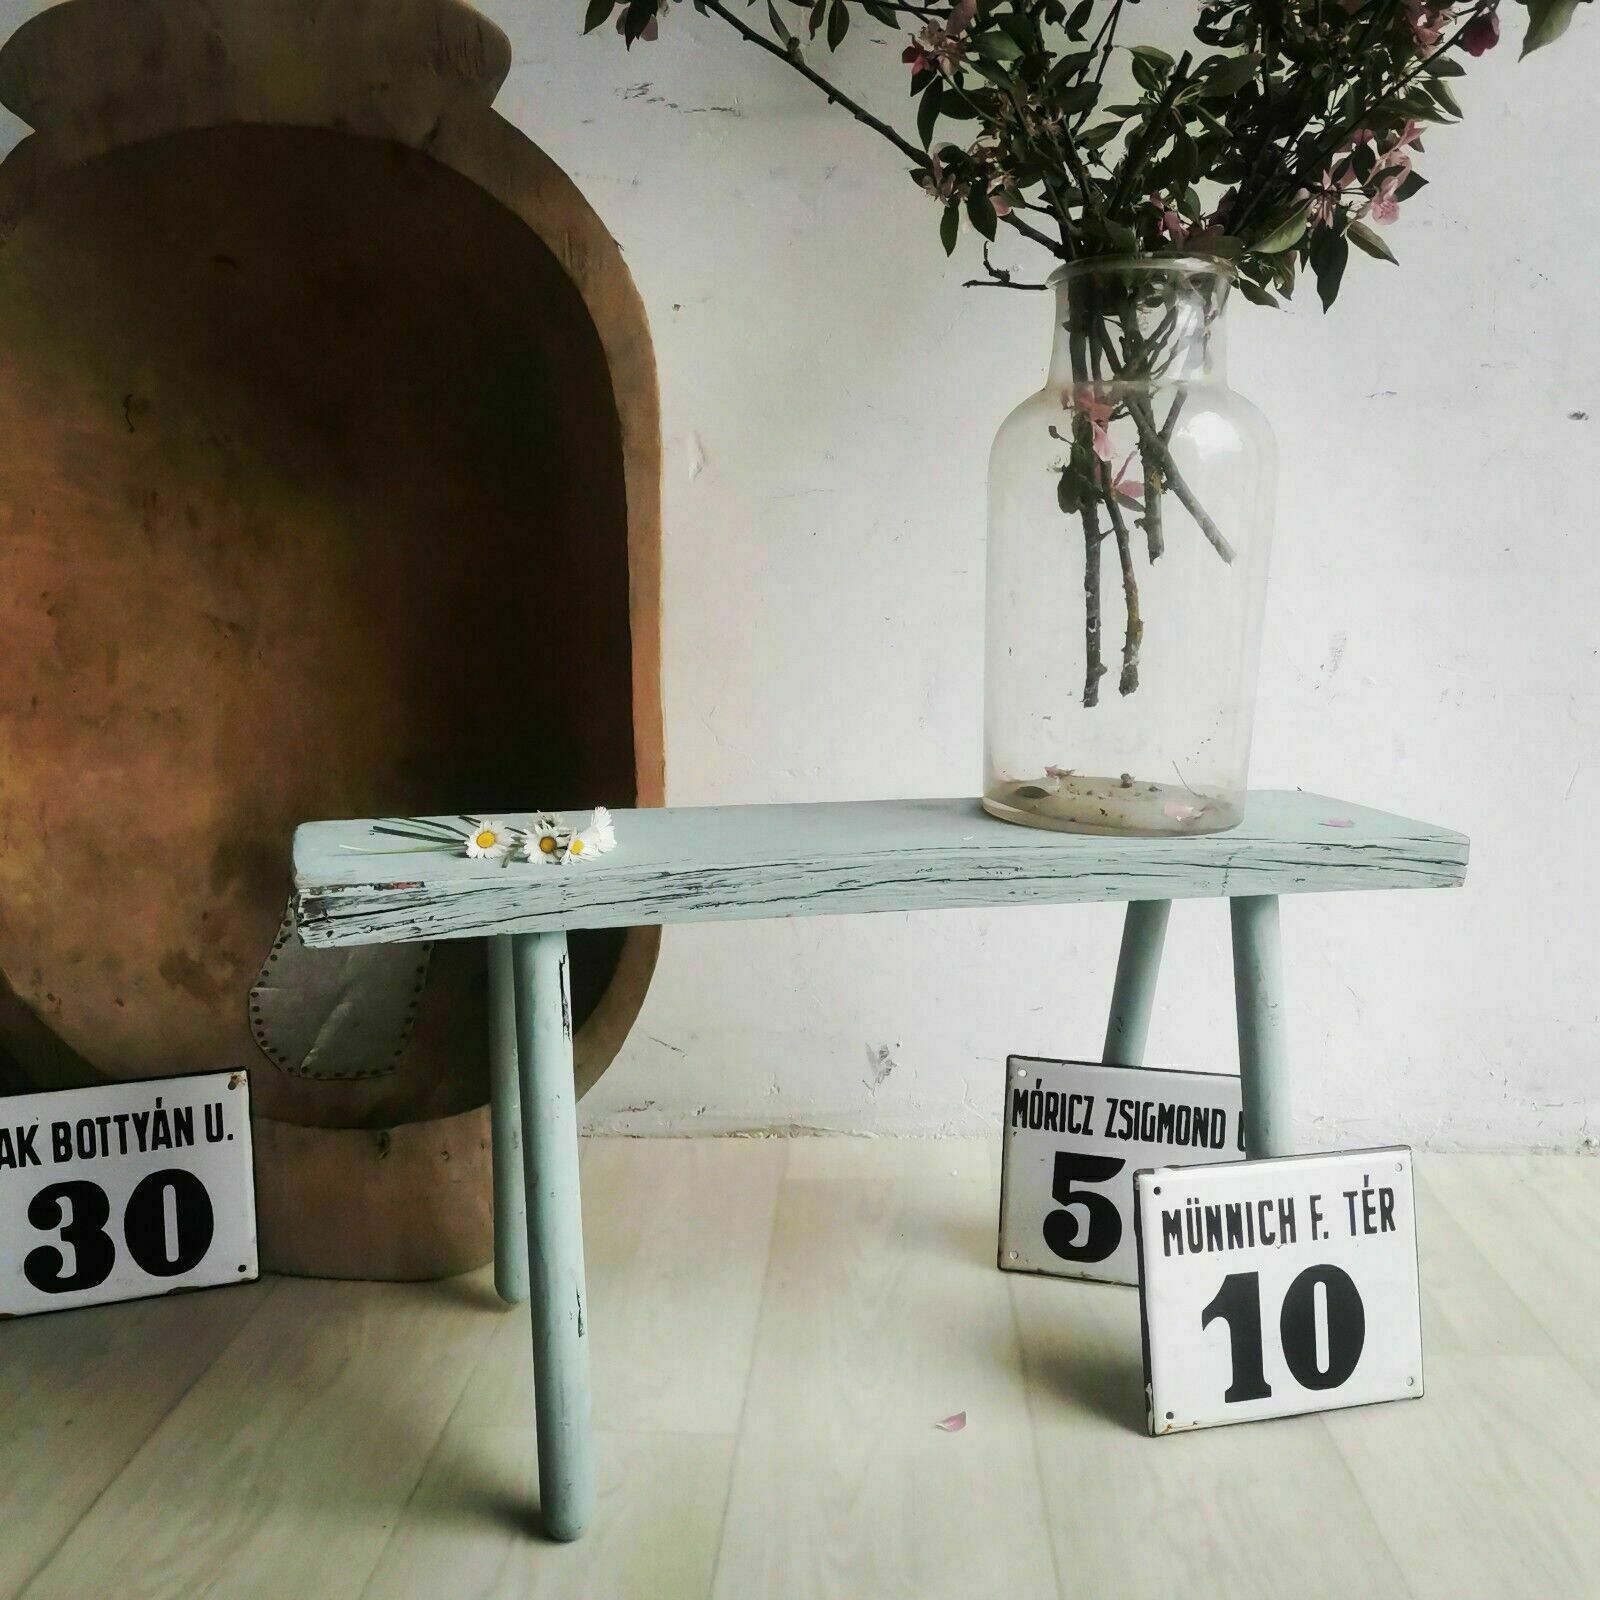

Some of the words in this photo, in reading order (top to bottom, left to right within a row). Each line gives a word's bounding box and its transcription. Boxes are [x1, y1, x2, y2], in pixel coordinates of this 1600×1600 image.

[51, 1096, 195, 1164] BOTTYÁN
[204, 1102, 234, 1143] U.
[1011, 1078, 1095, 1136] MÓRICZ
[1104, 1097, 1226, 1150] ZSIGMOND
[23, 1168, 214, 1294] 30
[1042, 1150, 1126, 1263] 5
[1161, 1197, 1297, 1257] MÜNNICH
[1309, 1194, 1329, 1241] F.
[1342, 1174, 1397, 1237] TÉR
[1201, 1263, 1366, 1404] 10
